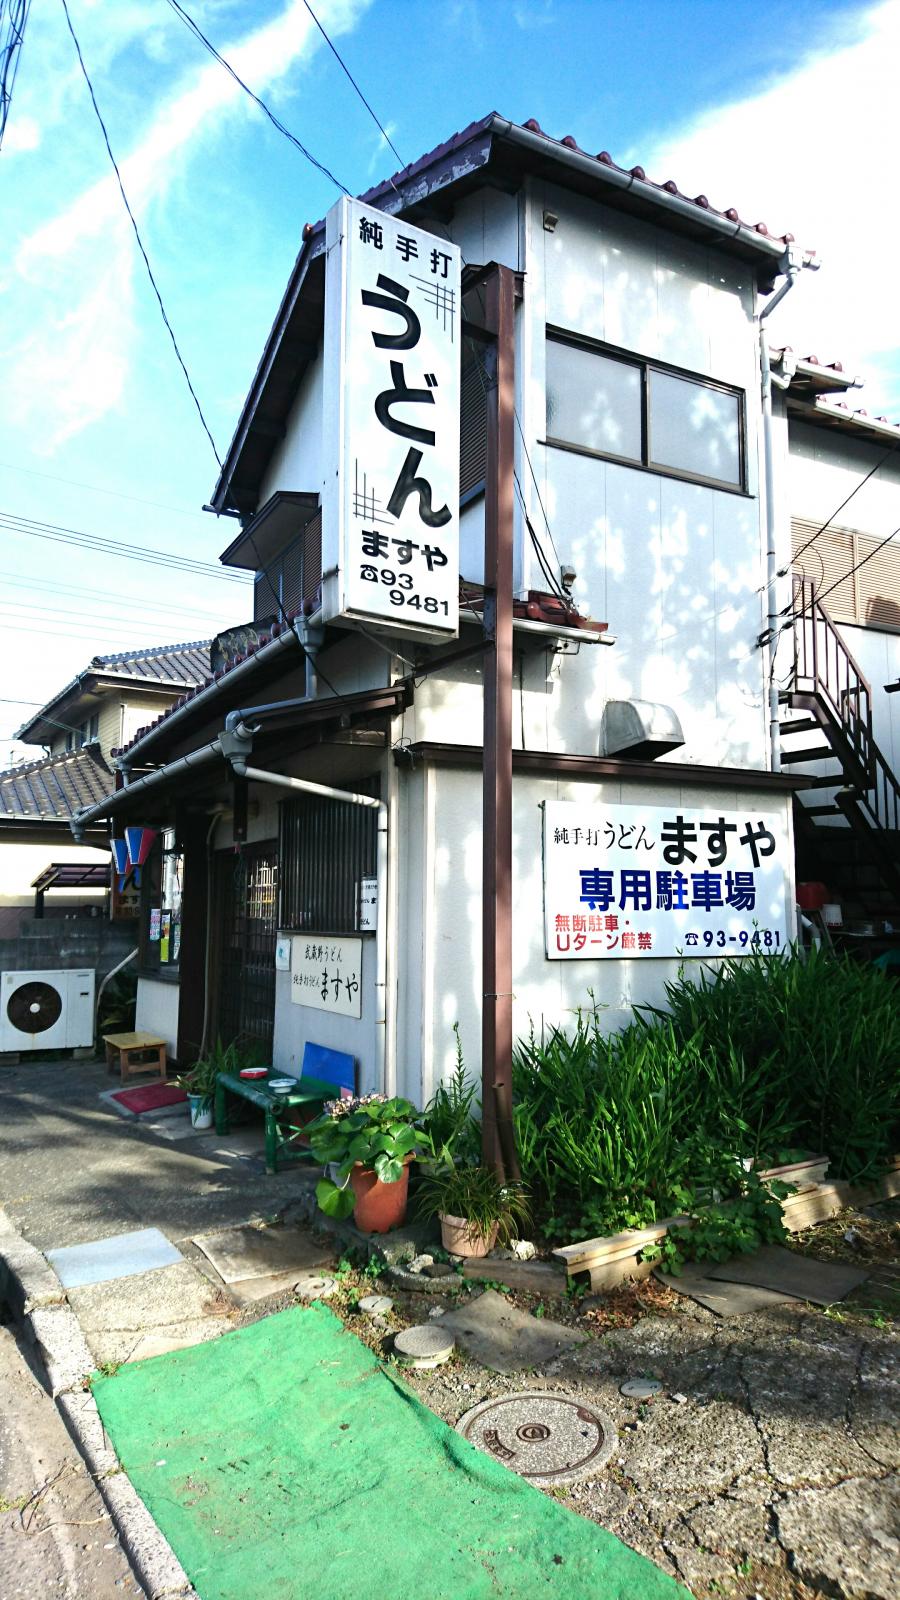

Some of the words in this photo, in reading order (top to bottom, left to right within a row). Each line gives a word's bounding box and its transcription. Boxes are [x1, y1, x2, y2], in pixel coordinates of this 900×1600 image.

[359, 217, 452, 278] 純手打
[361, 273, 452, 528] うどん
[361, 530, 448, 571] ますや
[380, 569, 414, 590] 93
[389, 589, 449, 616] 9481
[660, 815, 776, 868] ますや
[579, 867, 756, 912] 専用駐車場
[556, 932, 652, 951] Uターン厳禁
[703, 930, 780, 947] 93-9481
[320, 967, 359, 1003] ますや
